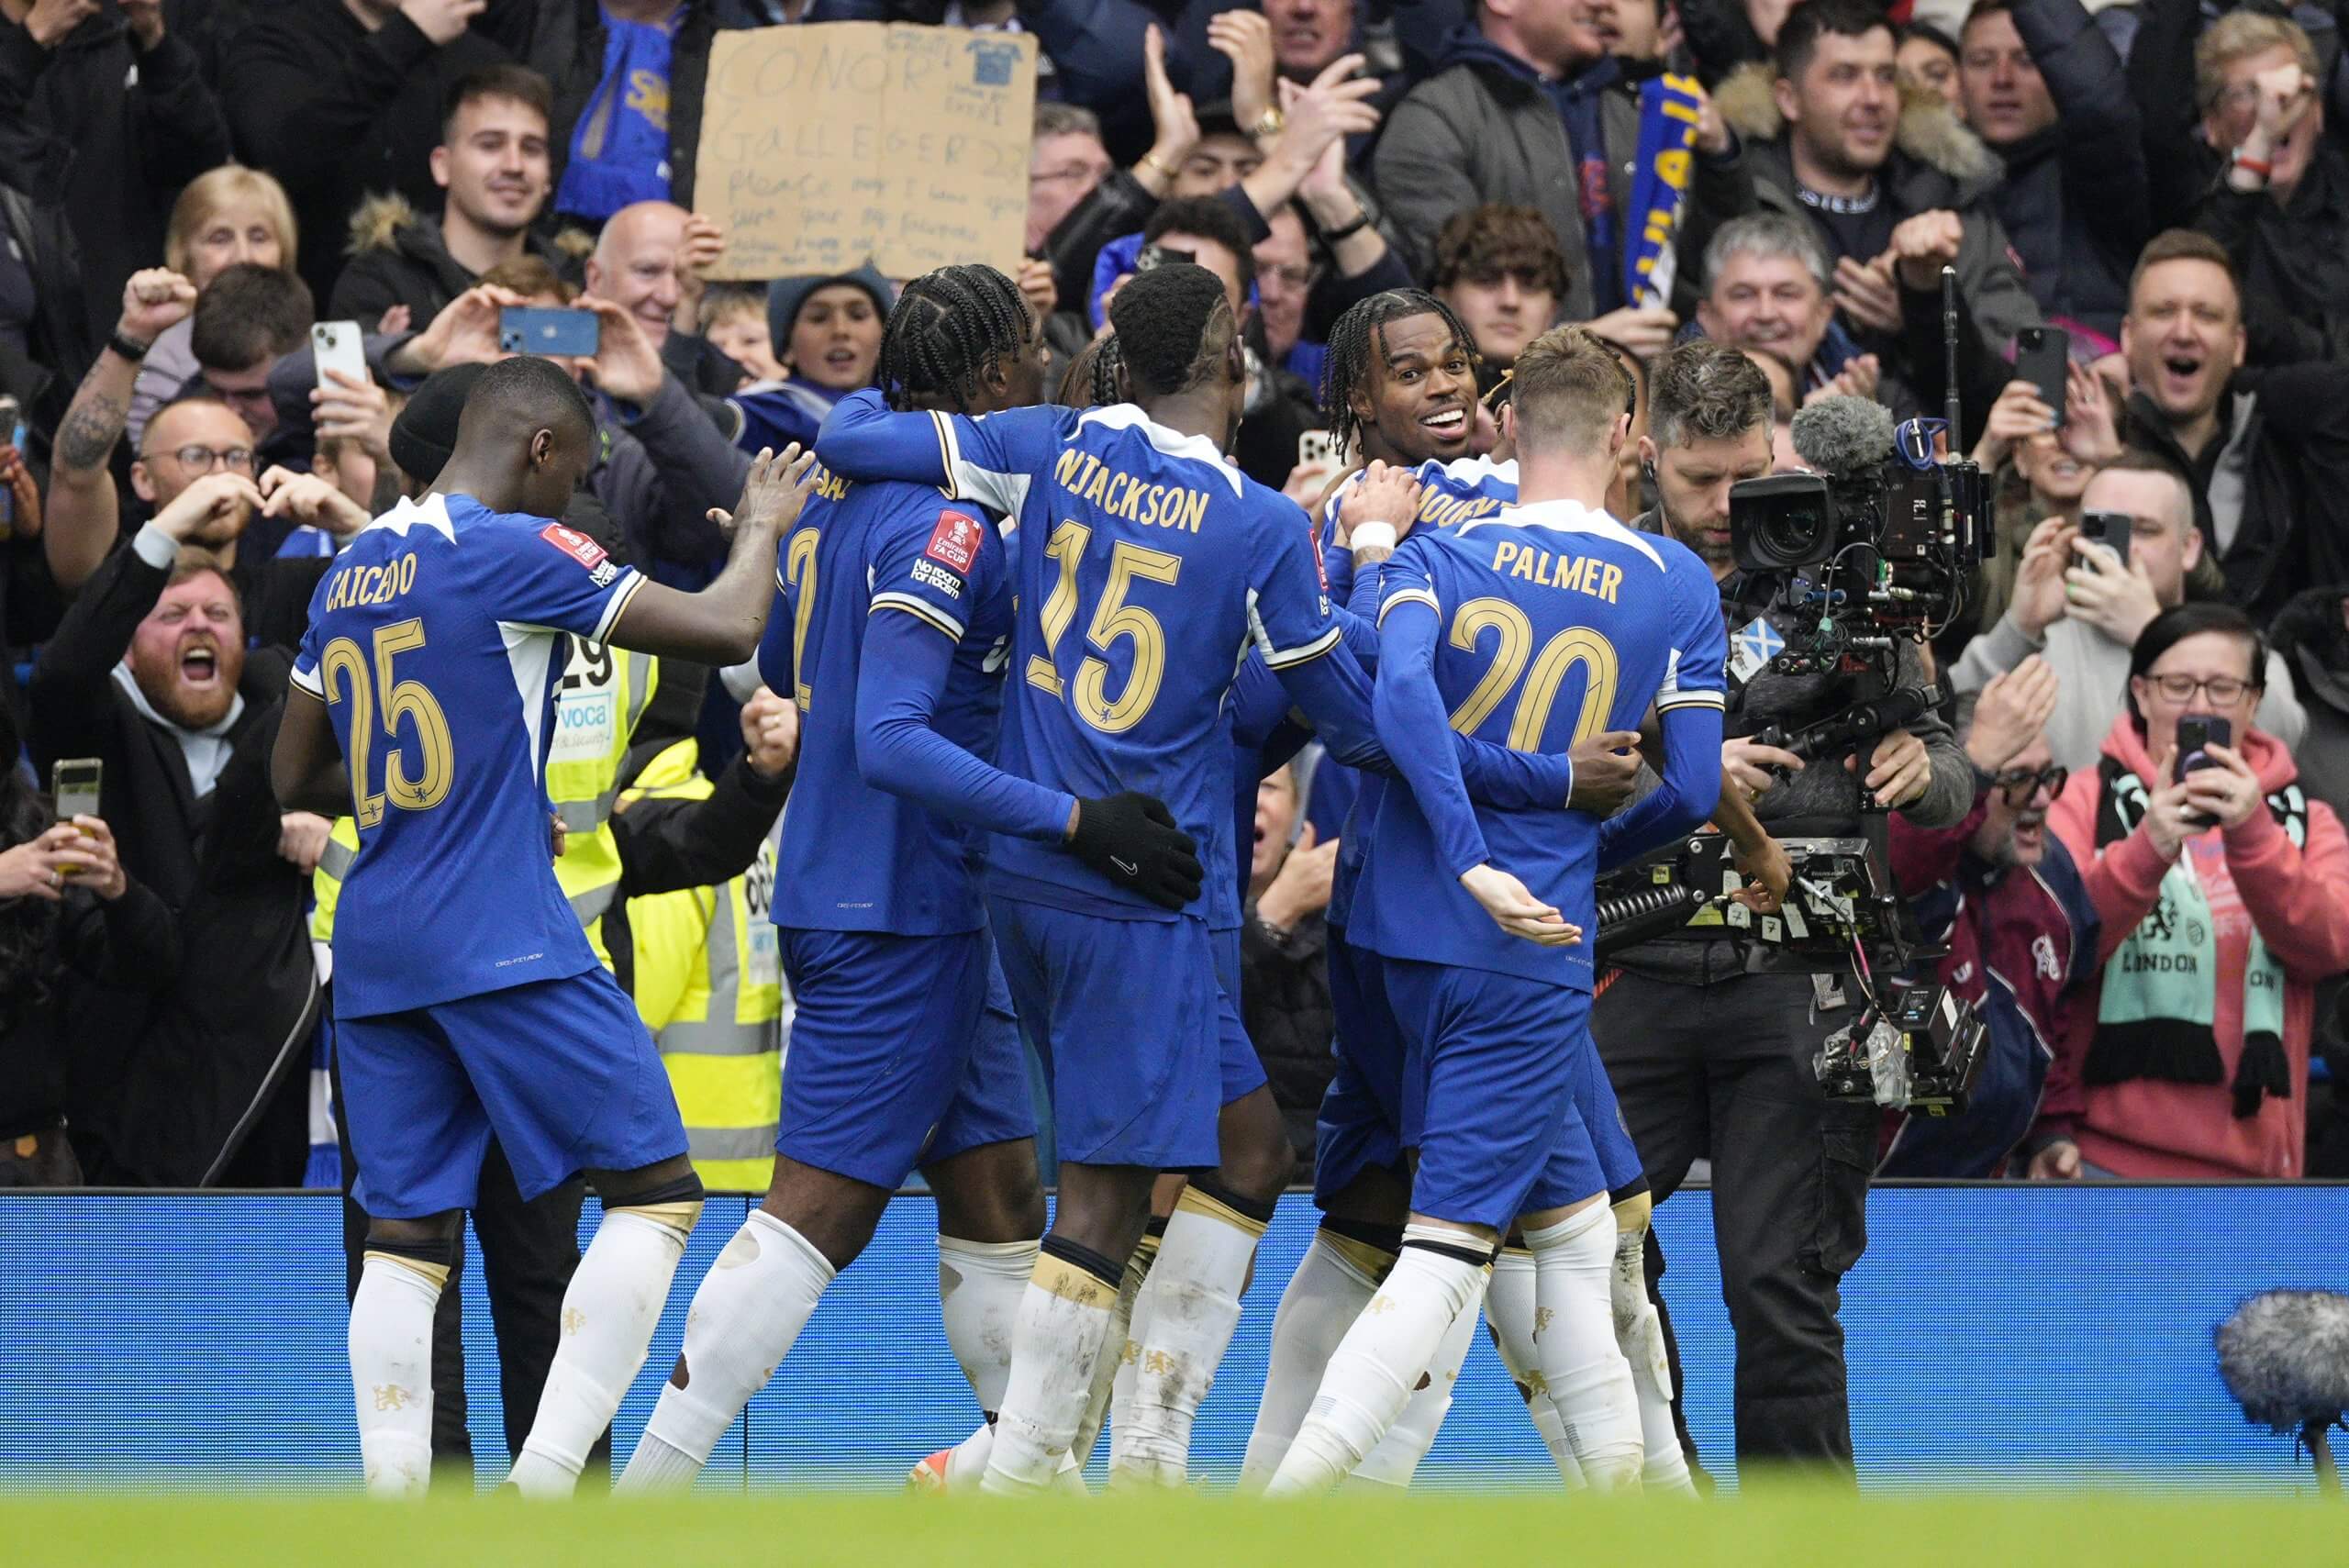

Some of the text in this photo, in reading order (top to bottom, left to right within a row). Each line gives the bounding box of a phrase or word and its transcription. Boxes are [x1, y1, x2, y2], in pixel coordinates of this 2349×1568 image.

[718, 37, 932, 101] CONOR
[326, 552, 417, 613] CAICEDO
[914, 558, 961, 589] No room
[933, 544, 966, 564] FA CUP
[1492, 541, 1623, 605] PALMER
[1026, 518, 1182, 733] 15
[1449, 596, 1619, 755] 20
[322, 617, 454, 829] 25
